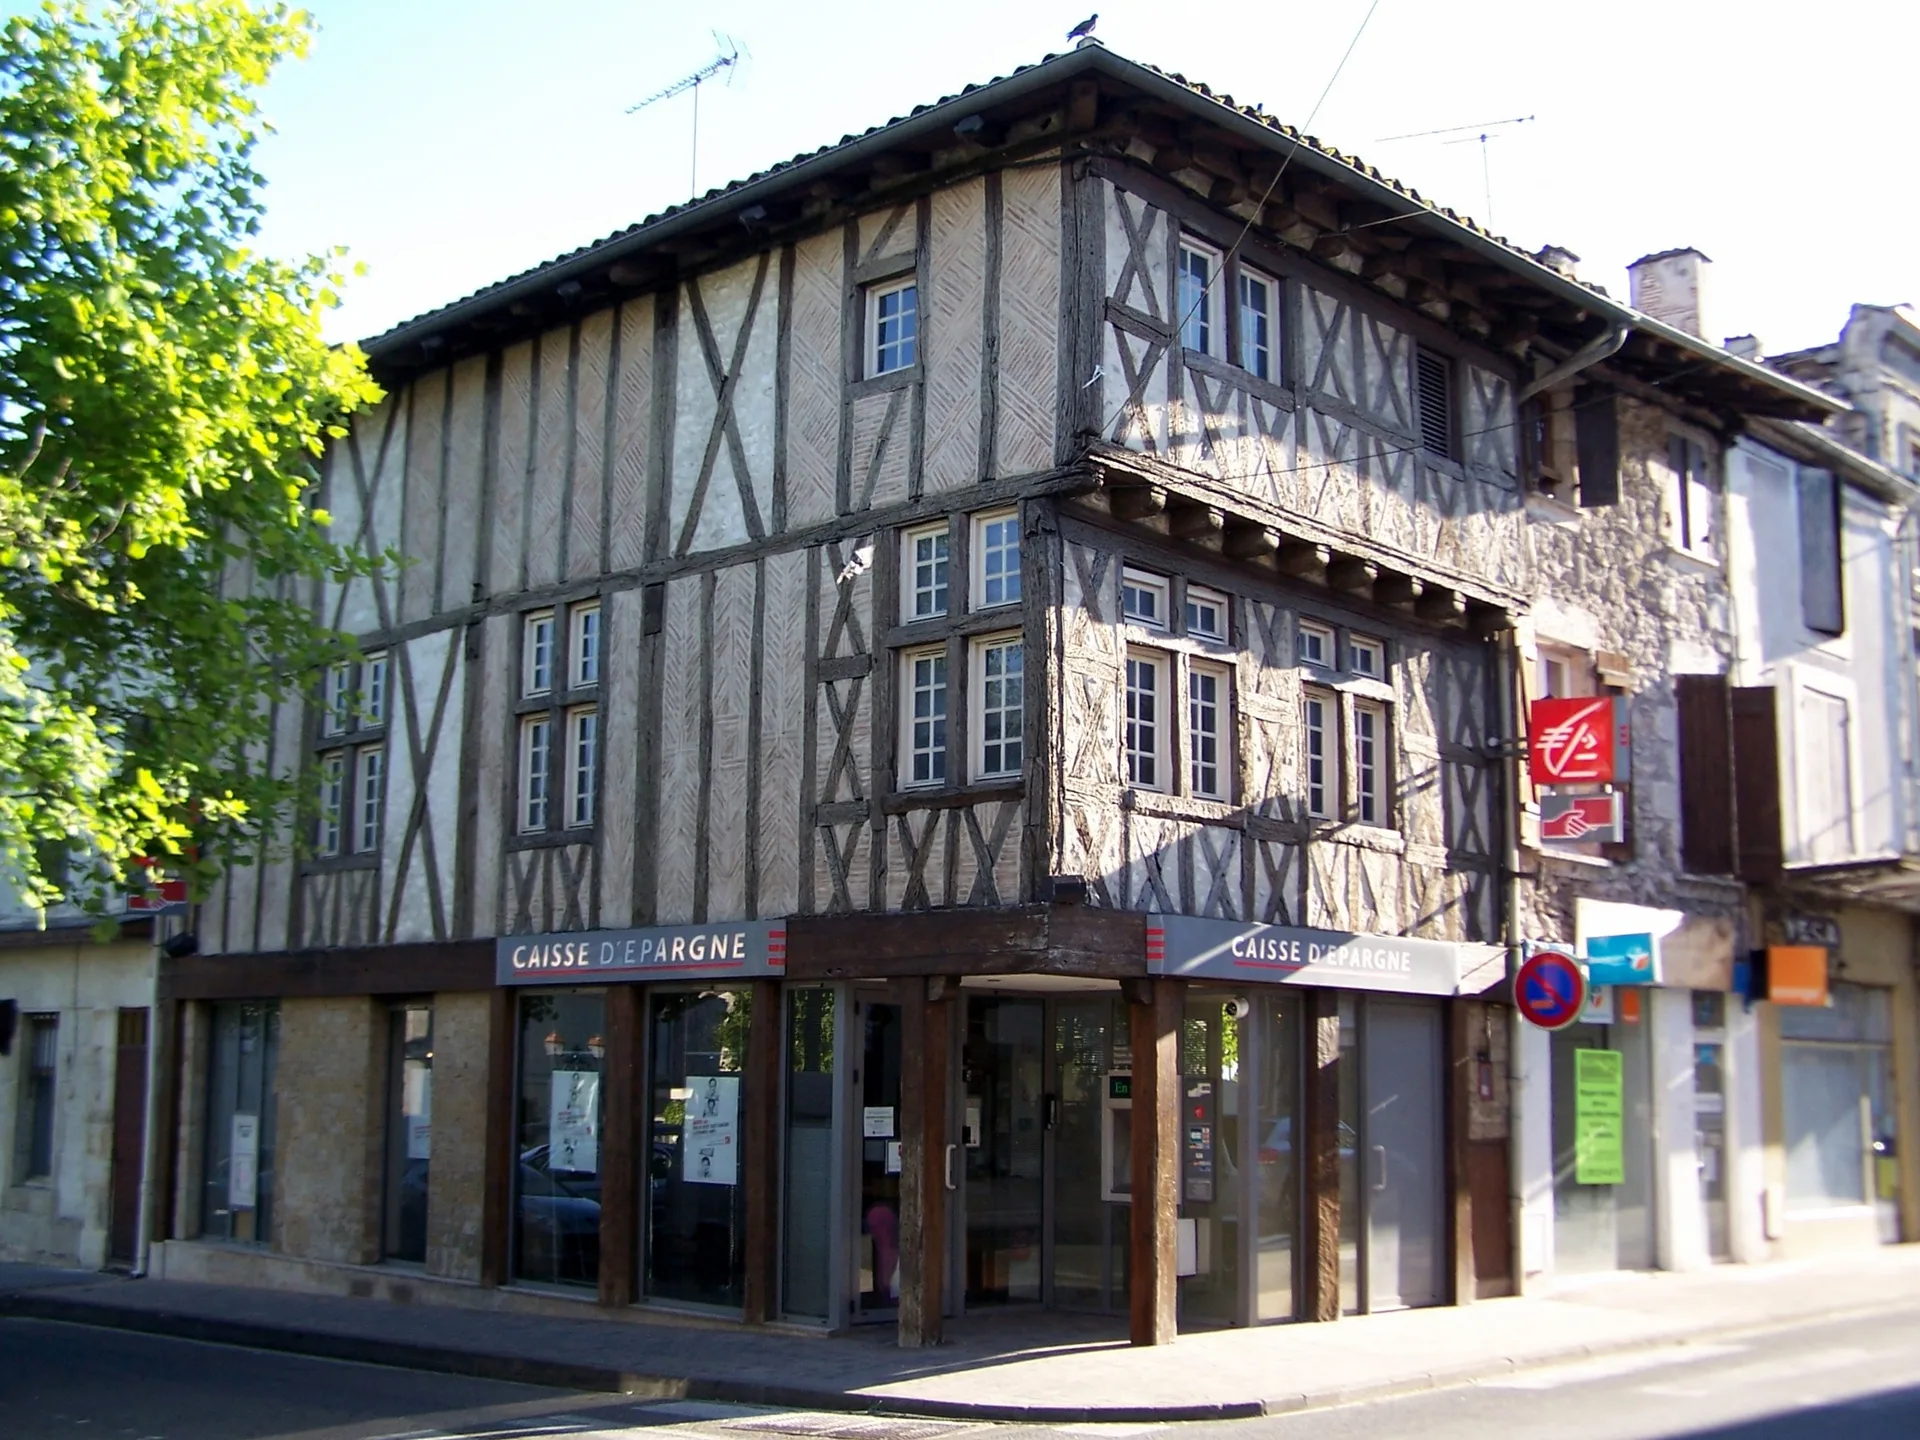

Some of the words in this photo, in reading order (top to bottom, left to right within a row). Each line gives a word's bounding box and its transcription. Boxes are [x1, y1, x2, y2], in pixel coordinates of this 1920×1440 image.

[512, 943, 589, 968] CAISSE
[600, 932, 746, 965] D'EPARGNE
[1232, 936, 1301, 962] CAISSE
[1309, 943, 1411, 972] D'EPARGNE
